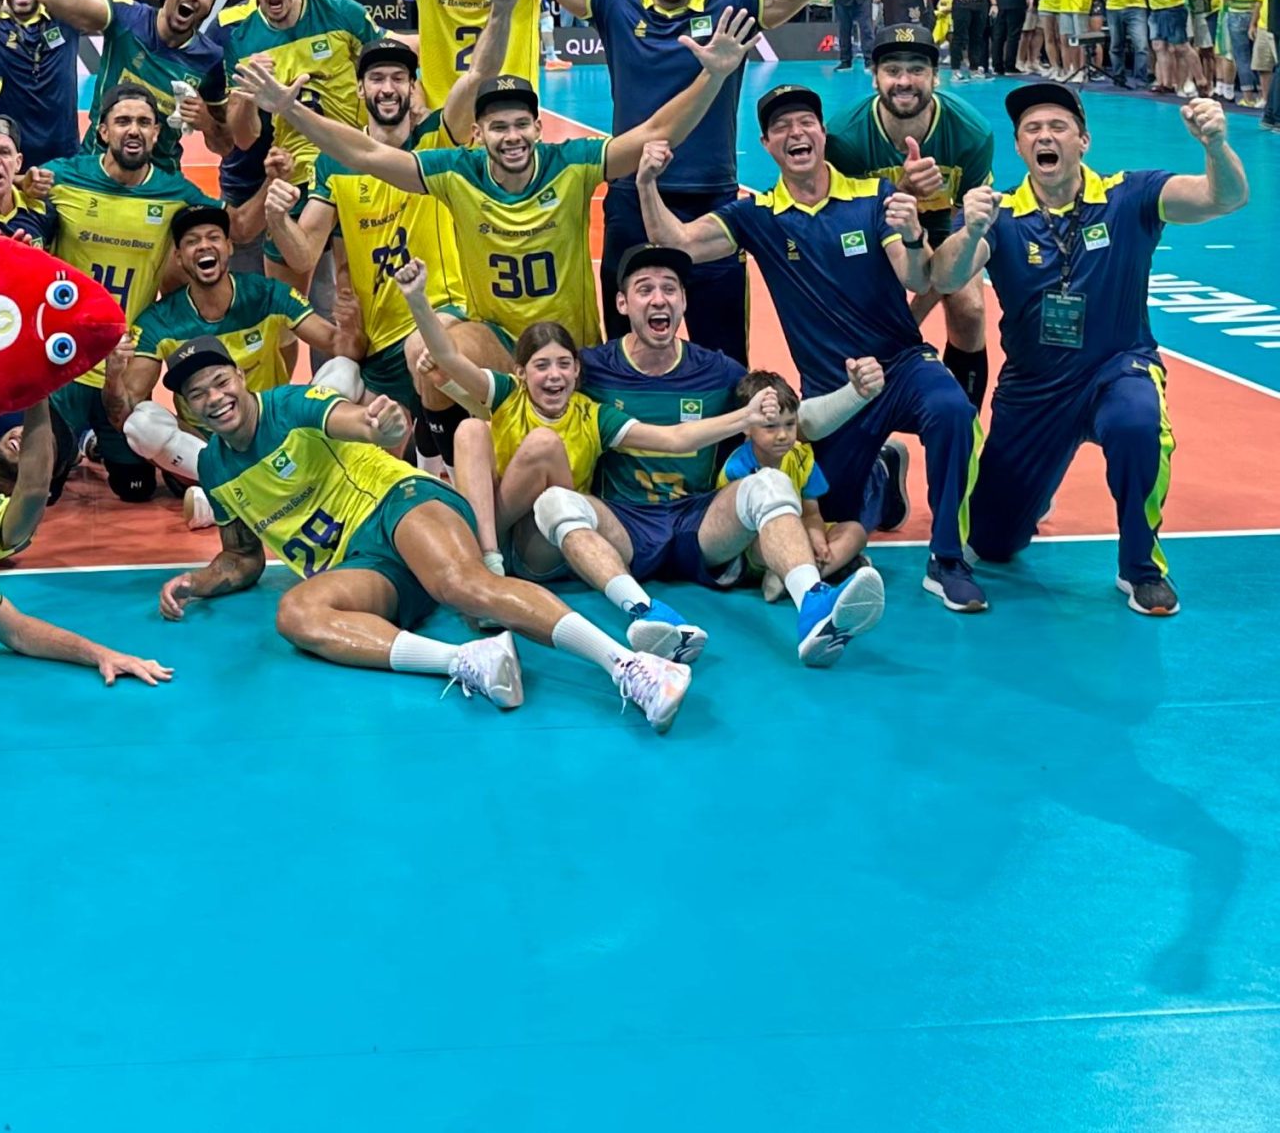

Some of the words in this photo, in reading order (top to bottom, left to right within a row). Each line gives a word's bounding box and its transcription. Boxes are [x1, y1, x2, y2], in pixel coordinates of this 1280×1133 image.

[92, 233, 119, 245] BANCO
[120, 239, 131, 247] DO
[489, 251, 557, 299] 30
